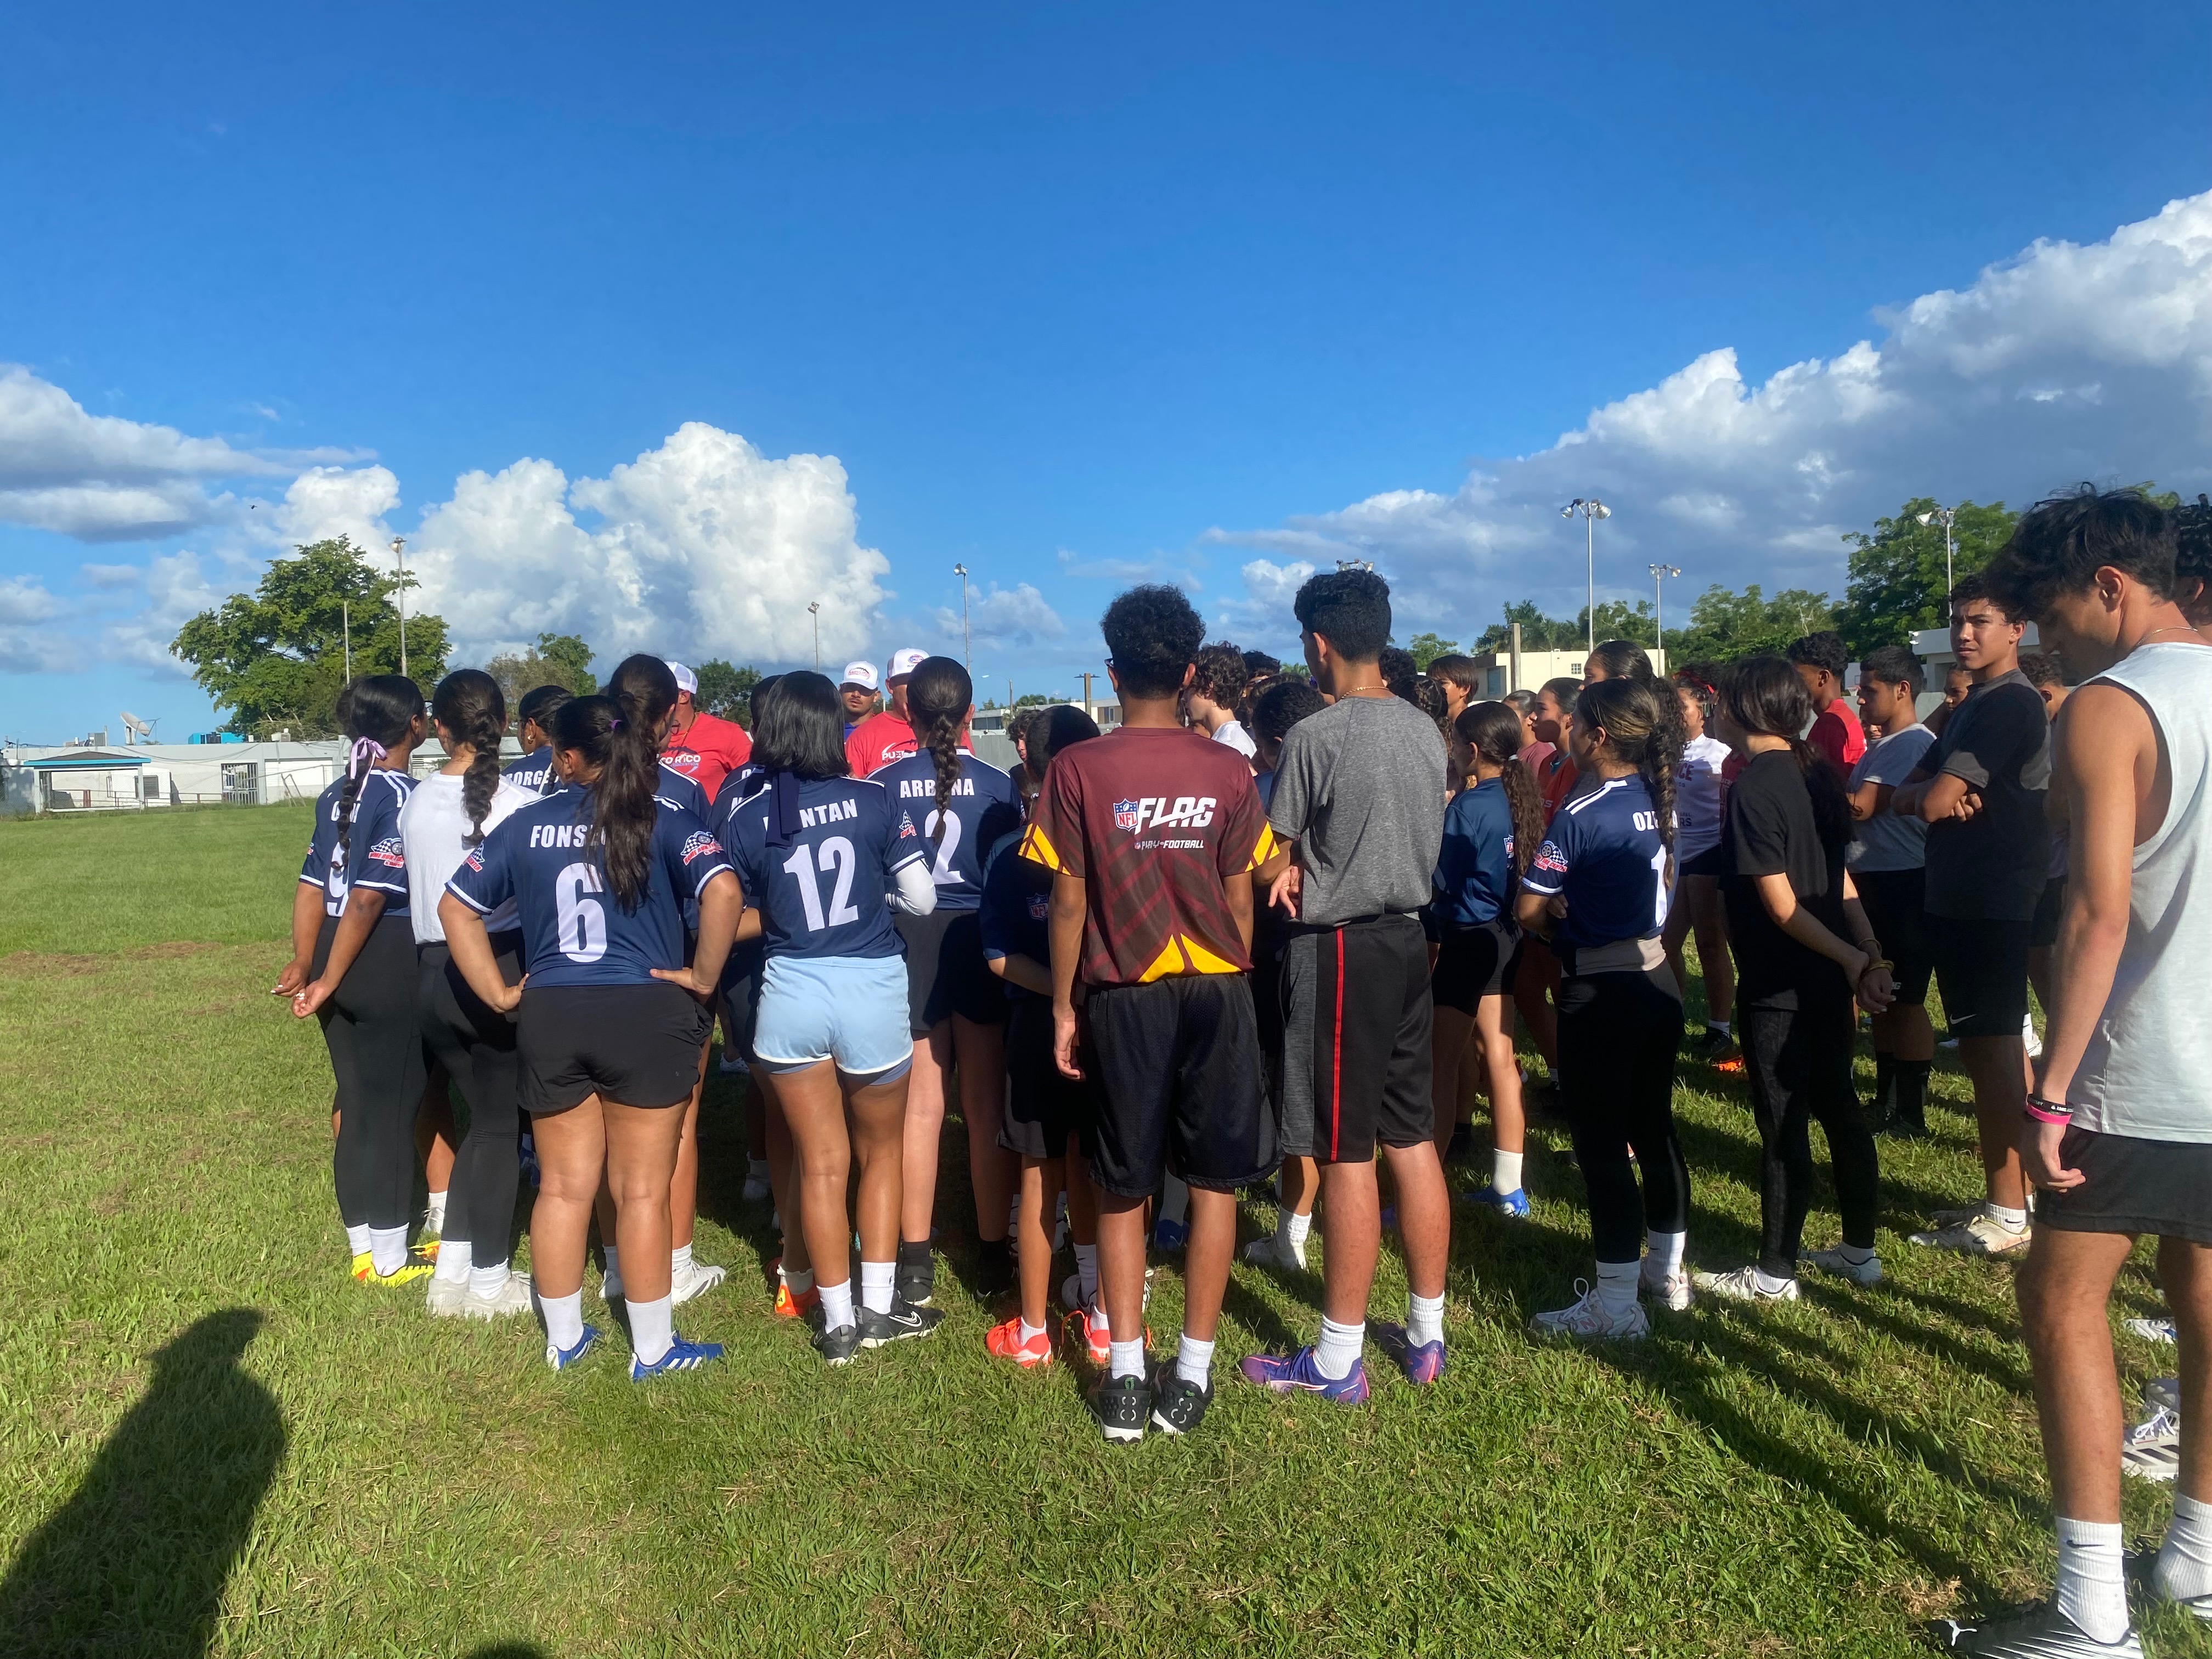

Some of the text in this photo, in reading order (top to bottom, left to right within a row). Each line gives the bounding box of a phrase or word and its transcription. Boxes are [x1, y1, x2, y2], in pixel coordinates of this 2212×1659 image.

[506, 770, 559, 786] ORGE
[900, 778, 975, 798] ARBNA
[763, 798, 858, 832] NTAN
[1118, 797, 1217, 836] NFL FLAG
[924, 809, 965, 885] 2
[1163, 840, 1204, 849] FOOTBALL
[782, 836, 859, 932] 12
[556, 862, 607, 963] 6
